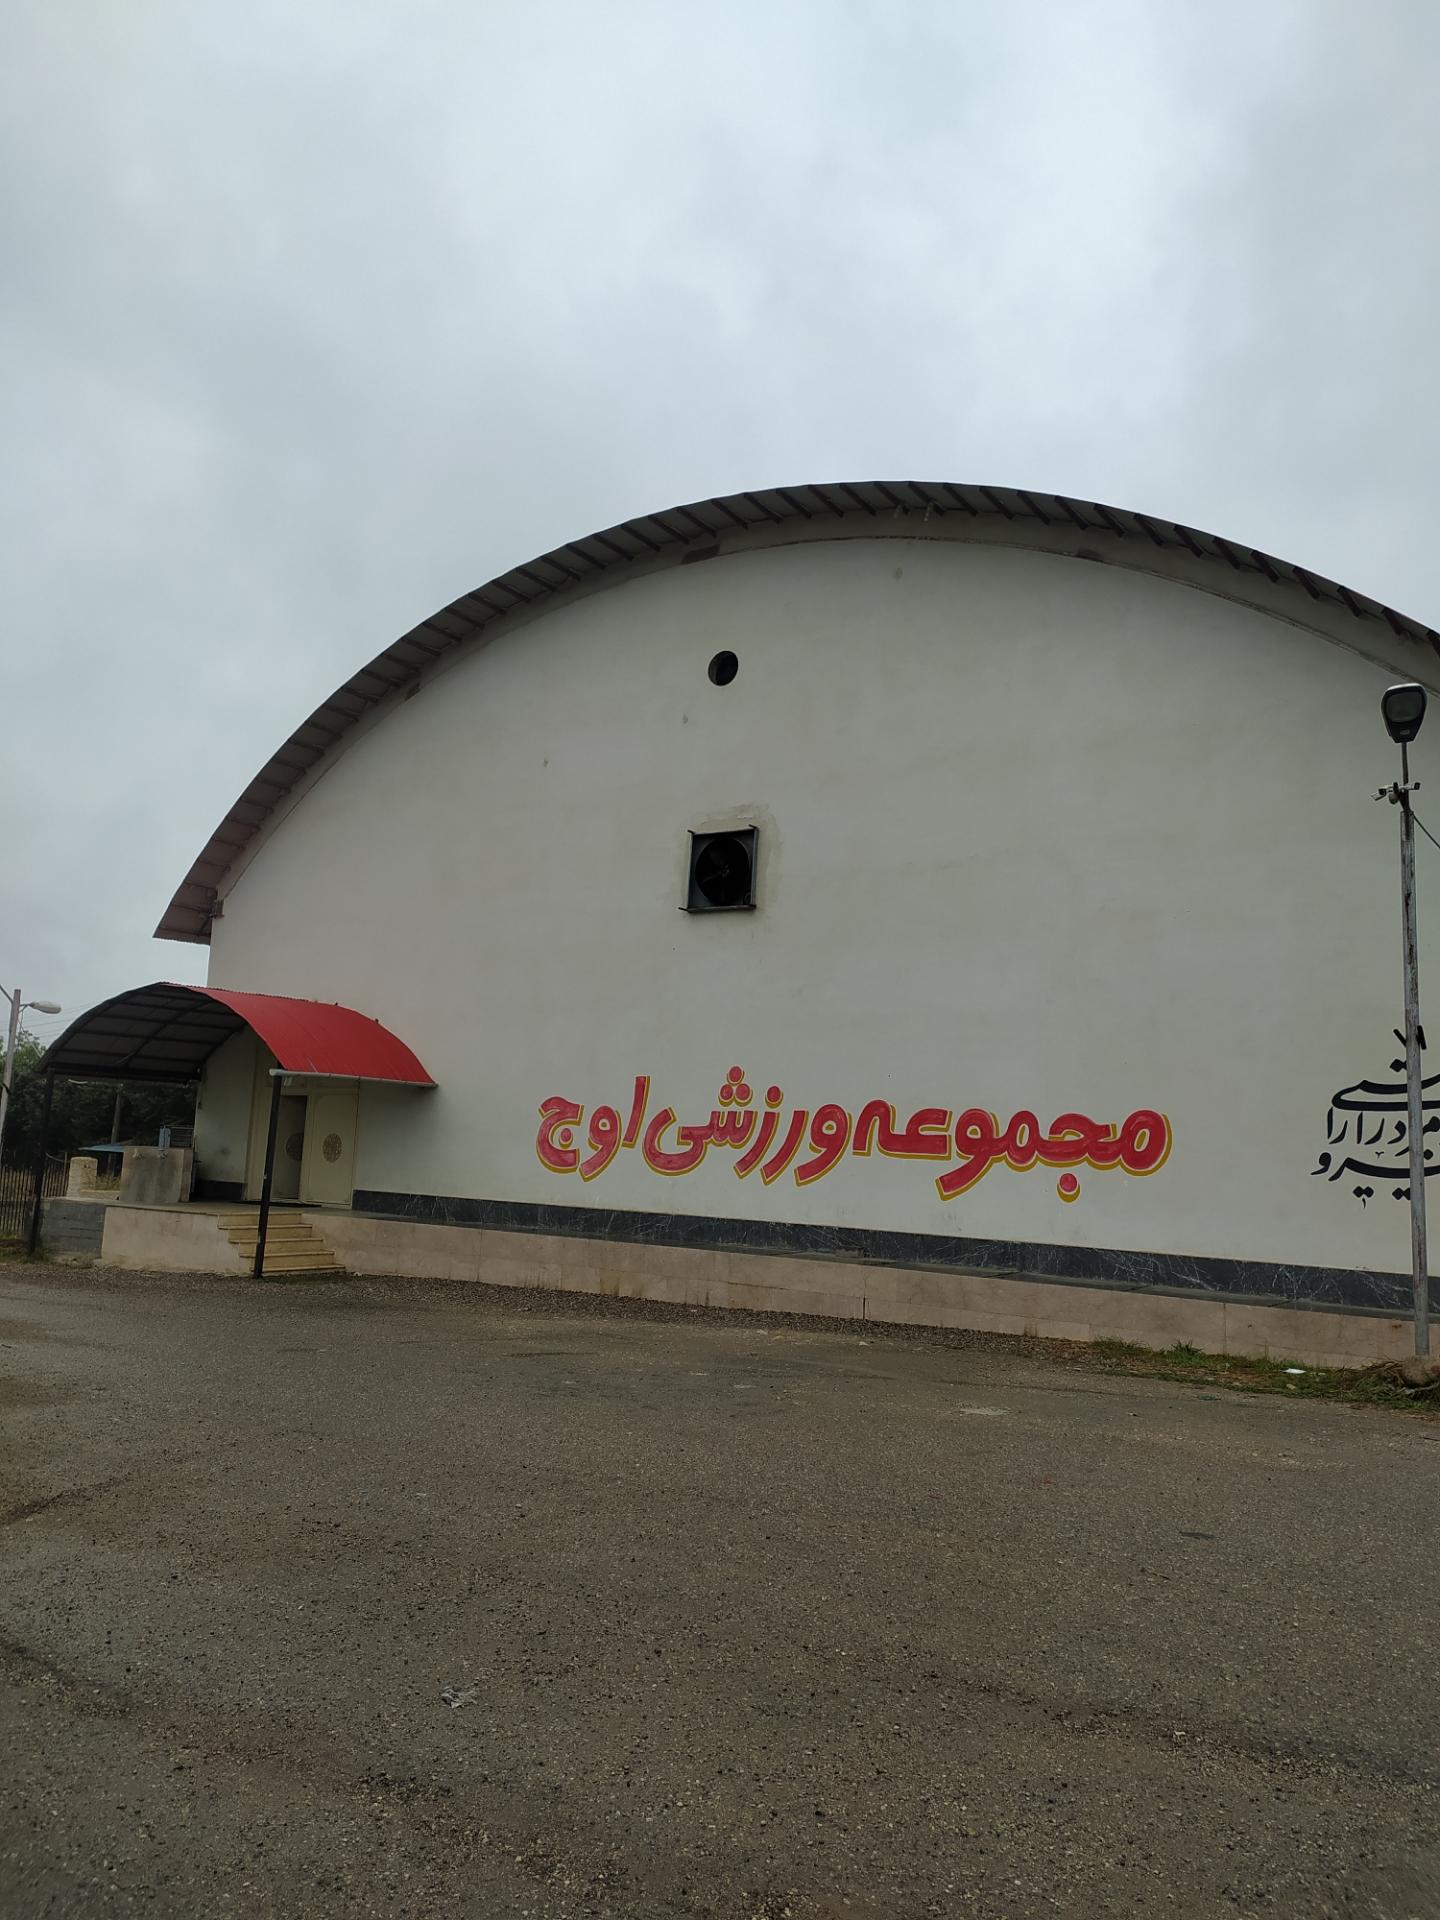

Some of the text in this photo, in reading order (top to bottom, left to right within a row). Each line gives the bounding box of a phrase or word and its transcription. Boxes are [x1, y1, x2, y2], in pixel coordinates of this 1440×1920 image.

[536, 1065, 1173, 1203] مجموعه ورزشی اوج
